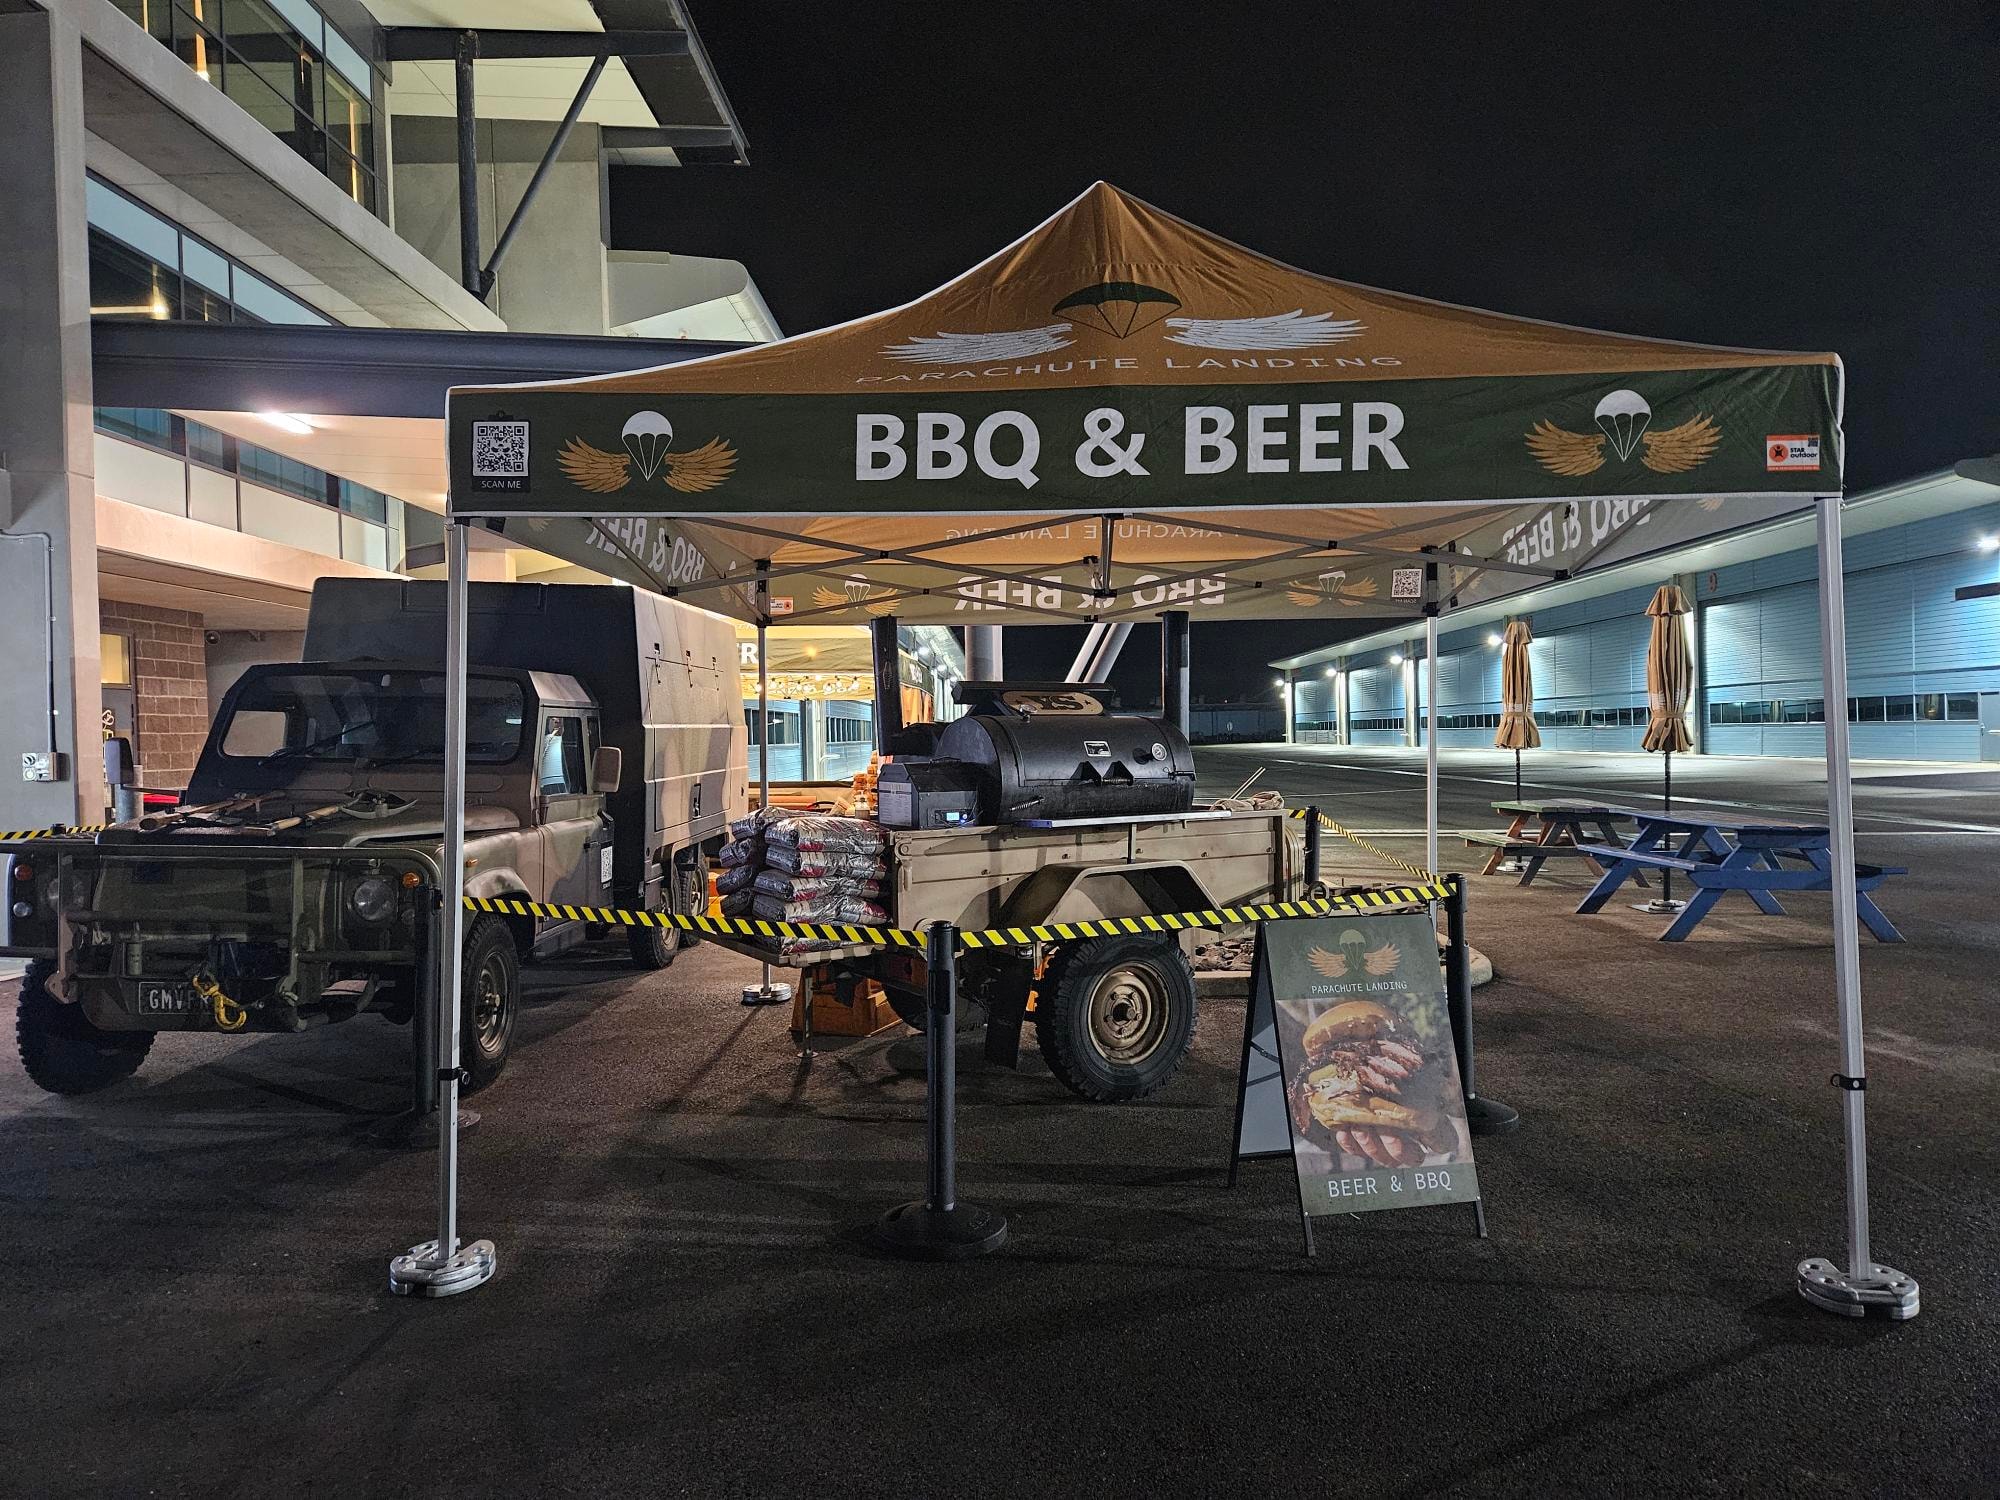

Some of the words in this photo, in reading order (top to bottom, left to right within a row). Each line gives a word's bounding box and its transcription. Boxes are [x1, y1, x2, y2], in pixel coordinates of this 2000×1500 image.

[855, 358, 1139, 383] PARACHUTE
[1166, 357, 1402, 368] LANDING
[856, 410, 1040, 490] BBQ
[1074, 407, 1151, 478] &
[1184, 401, 1410, 476] BEER
[481, 480, 504, 488] SCAN
[507, 480, 521, 488] ME
[1311, 983, 1363, 994] PARACHUTE
[1366, 981, 1408, 992] LANDING
[1328, 1177, 1378, 1198] BEER
[1390, 1175, 1403, 1193] &
[1415, 1171, 1452, 1191] BBQ
